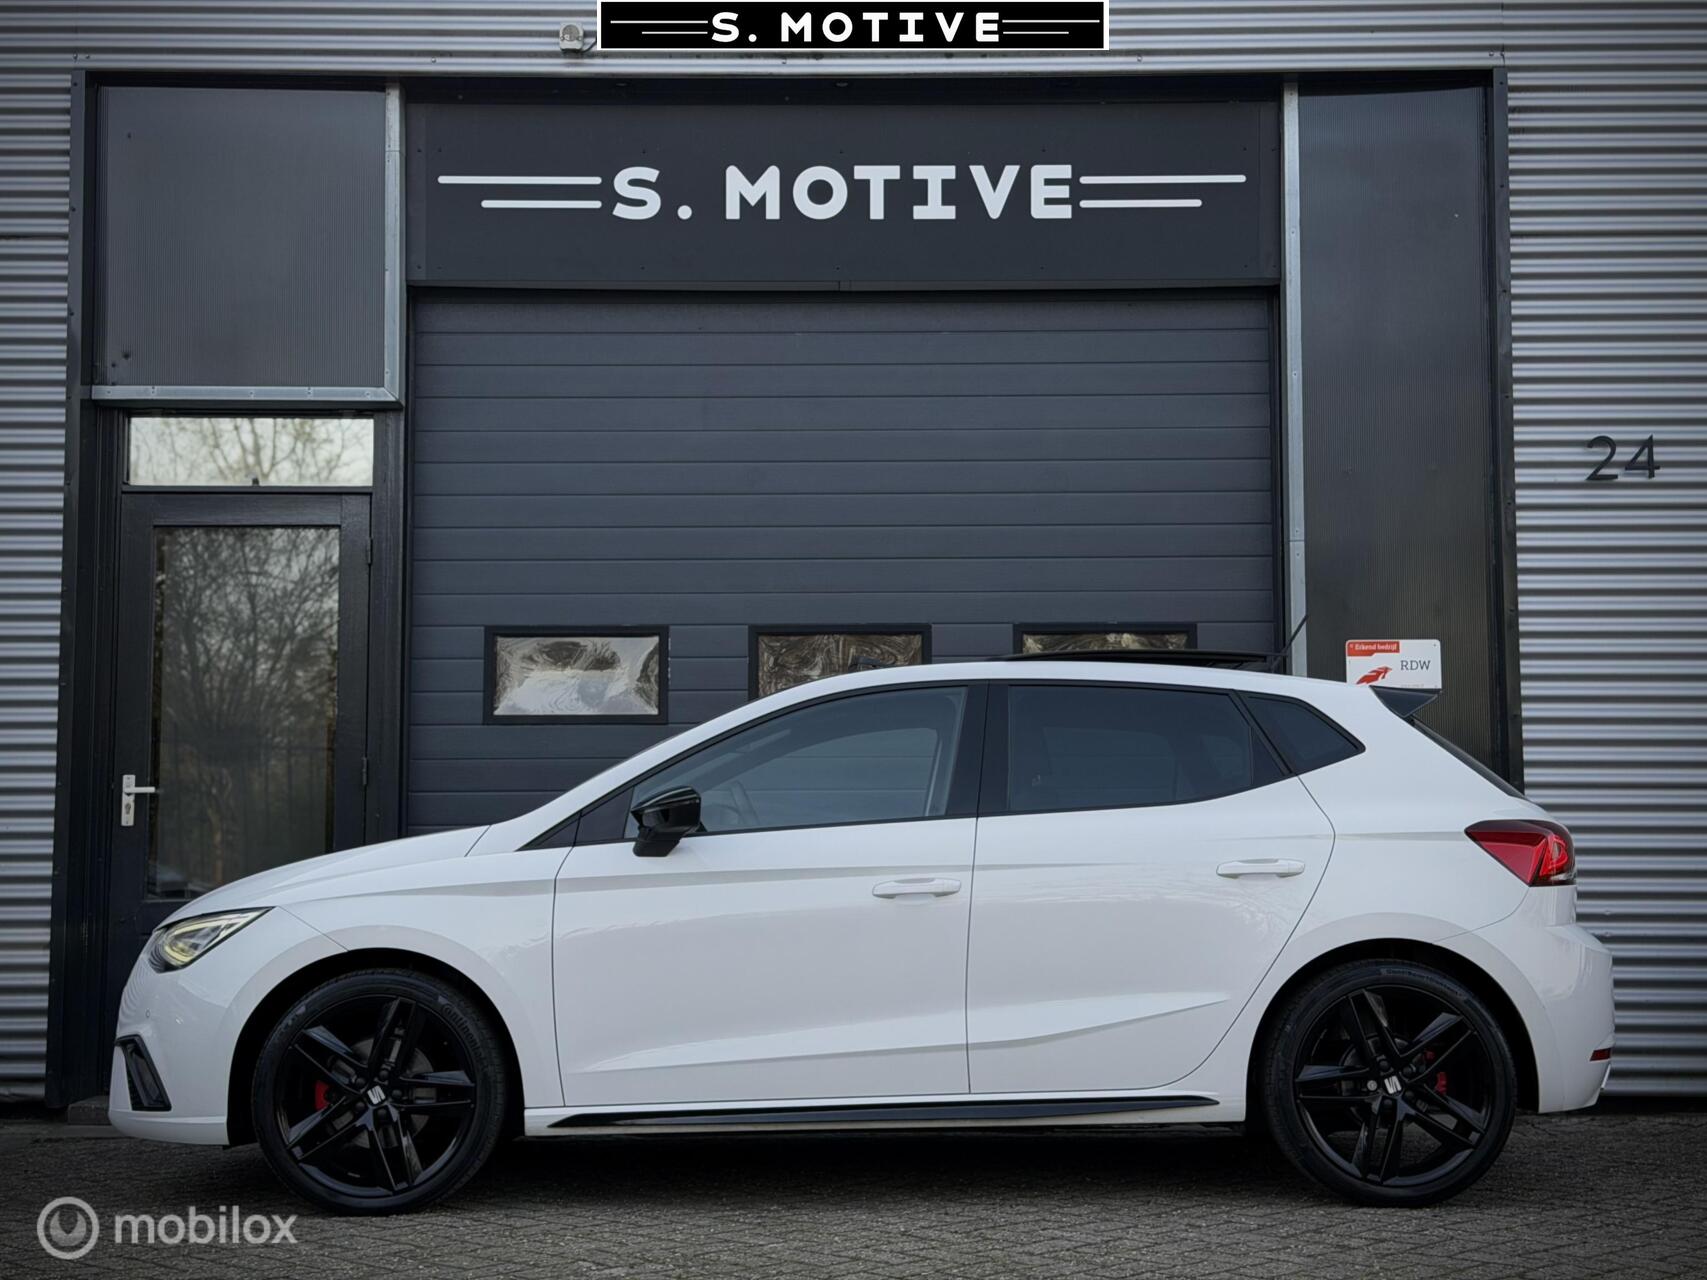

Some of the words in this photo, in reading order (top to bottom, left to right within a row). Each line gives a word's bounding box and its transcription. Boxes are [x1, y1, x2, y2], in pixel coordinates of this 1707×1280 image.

[612, 165, 693, 220] S.
[725, 164, 1073, 220] MOTIVE
[1585, 434, 1661, 480] 24
[1354, 643, 1376, 651] Erkend
[1377, 643, 1397, 652] bedrijf
[1400, 660, 1431, 671] RDW
